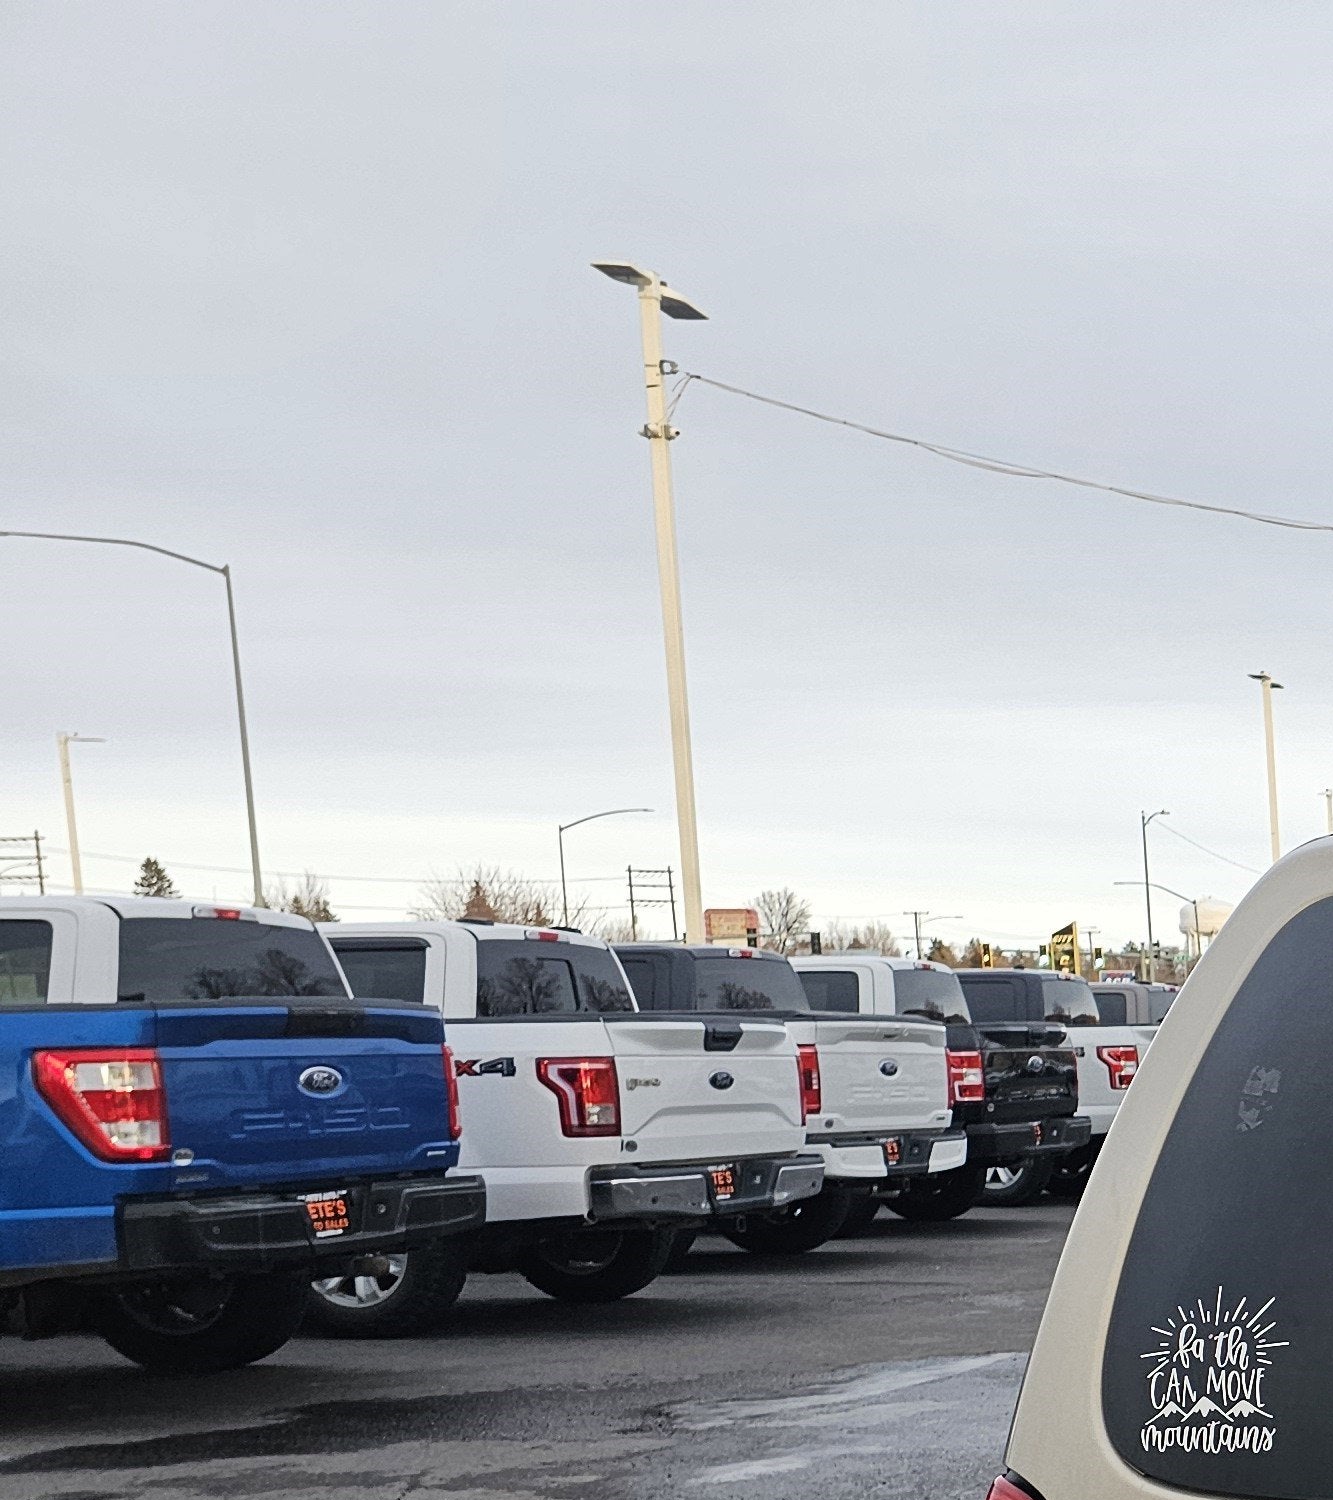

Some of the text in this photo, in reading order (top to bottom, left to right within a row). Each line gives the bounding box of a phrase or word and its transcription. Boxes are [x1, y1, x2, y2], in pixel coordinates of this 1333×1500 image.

[306, 1199, 348, 1220] ETE'S
[1150, 1365, 1266, 1410] CAN MOVE
